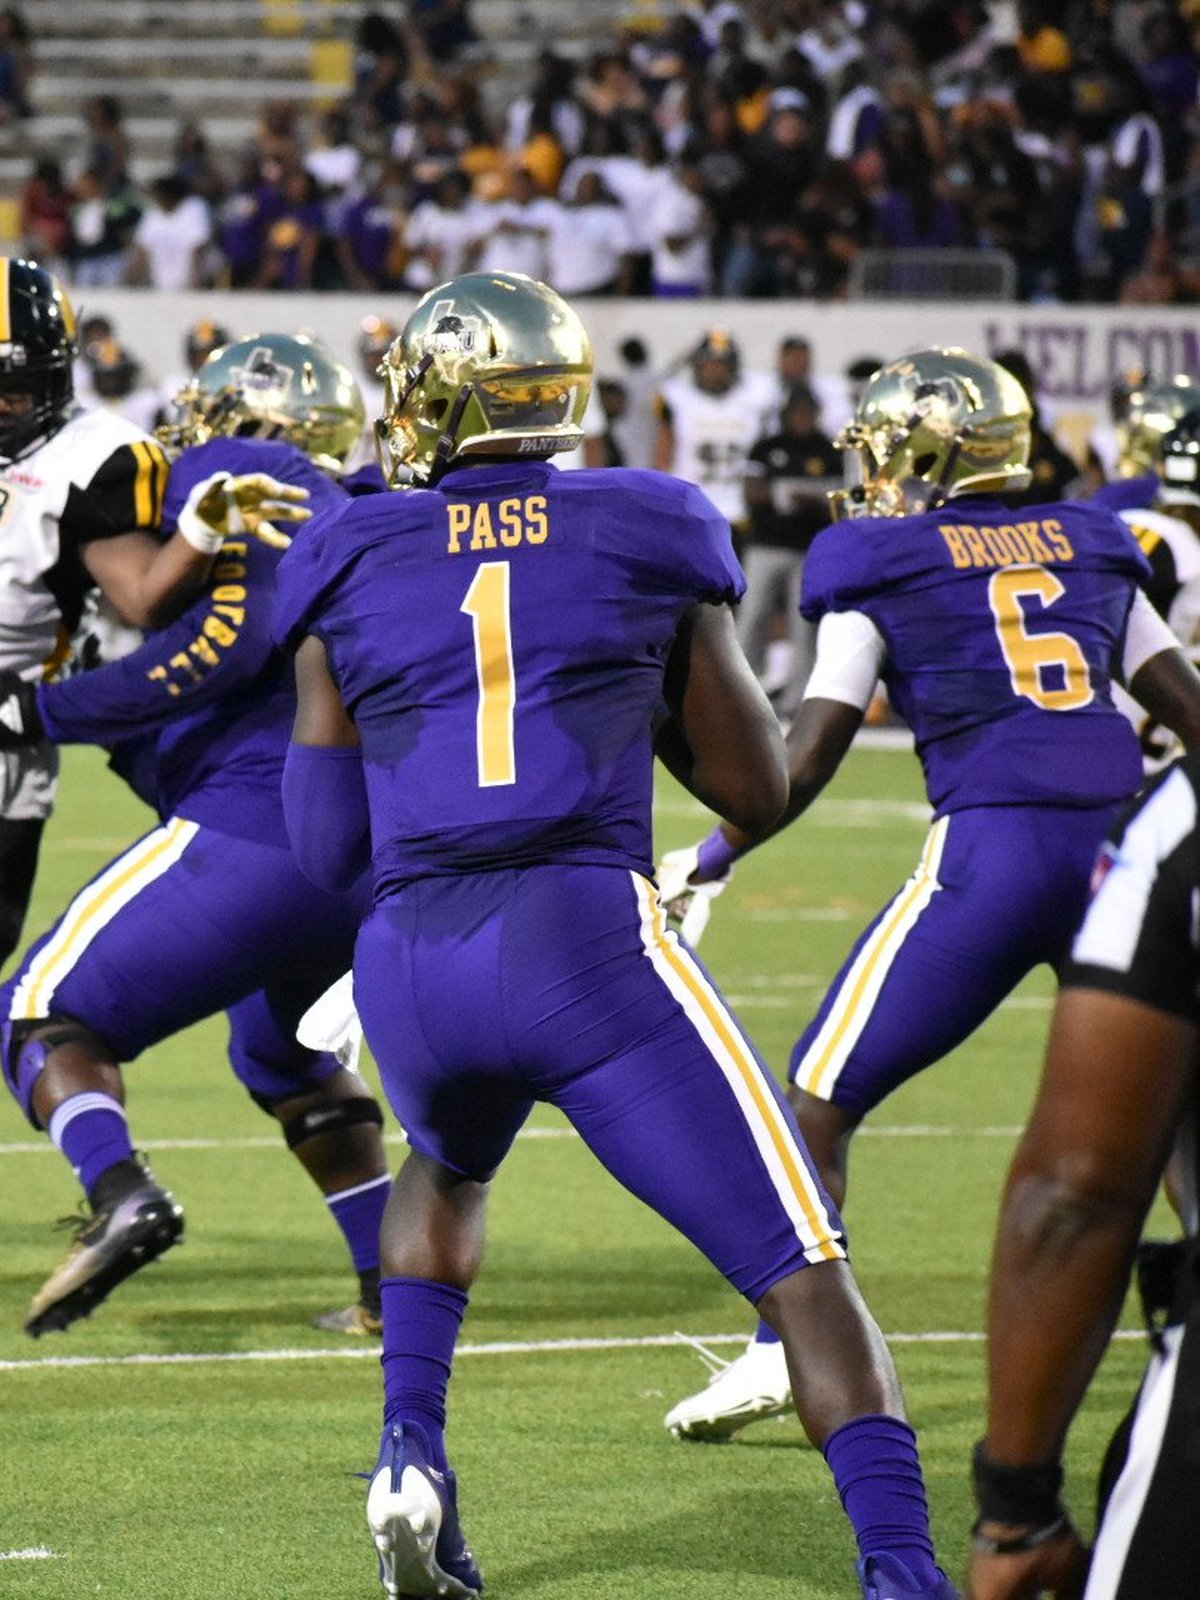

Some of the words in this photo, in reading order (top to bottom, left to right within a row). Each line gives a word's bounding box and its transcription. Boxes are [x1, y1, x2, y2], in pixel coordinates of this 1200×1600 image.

[985, 322, 1200, 396] ELCO
[447, 496, 549, 553] PASS
[938, 521, 1074, 568] BROOKS
[460, 561, 516, 788] 1
[989, 563, 1095, 712] 6
